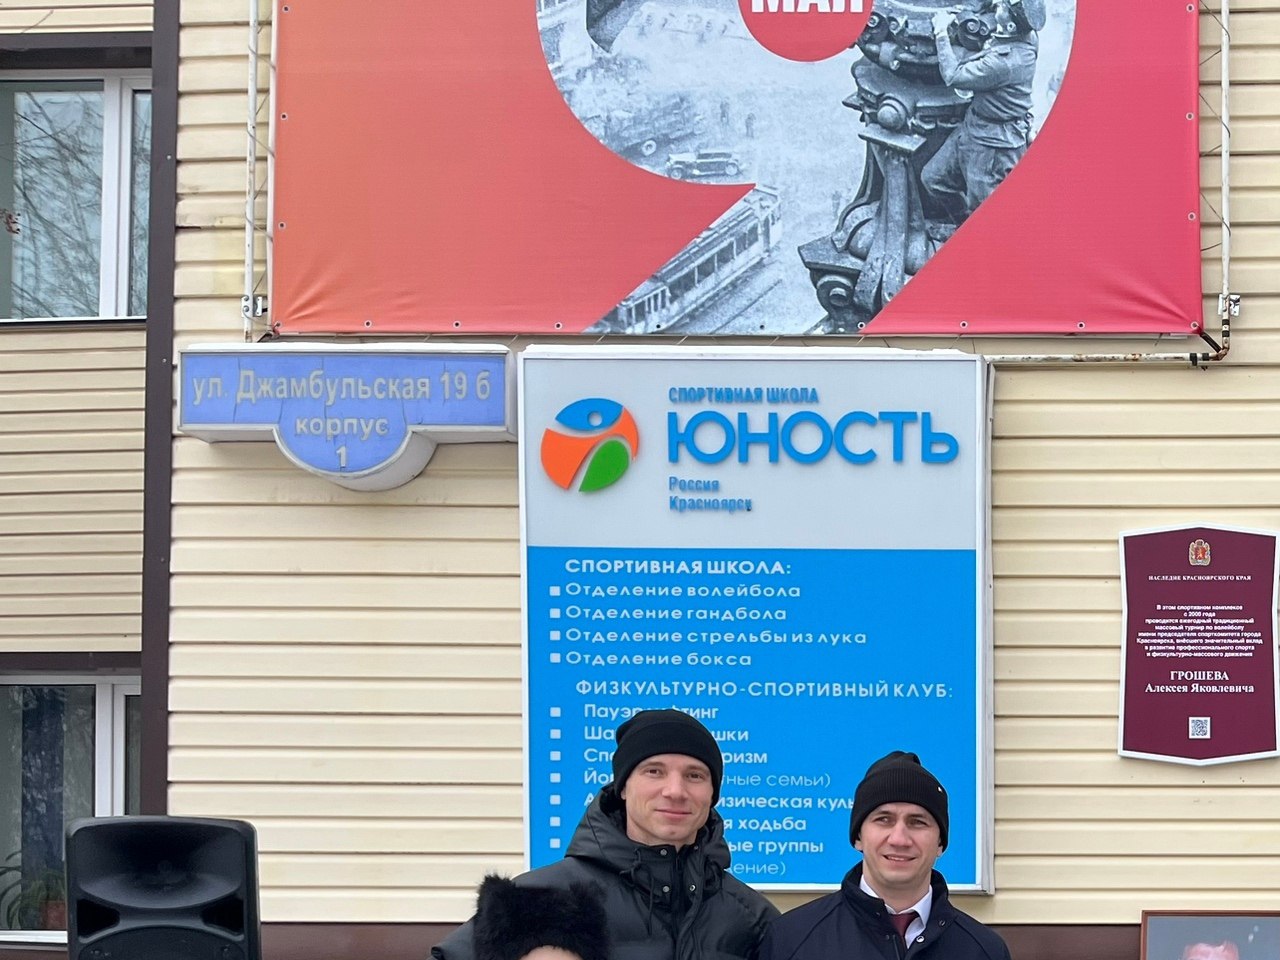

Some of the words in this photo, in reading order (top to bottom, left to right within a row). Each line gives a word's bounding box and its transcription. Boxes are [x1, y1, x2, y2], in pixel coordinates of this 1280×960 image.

[192, 376, 228, 405] ул.
[236, 369, 431, 405] Джамбульская
[440, 371, 468, 400] 19
[668, 387, 763, 404] СПОРТИВНАЯ
[766, 387, 820, 404] ШКОЛА
[295, 416, 389, 441] корпус
[667, 410, 959, 465] ЮНОСТЬ
[335, 446, 347, 468] 1
[669, 476, 720, 493] Россия
[669, 496, 752, 514] Красноярск
[565, 559, 703, 575] СПОРТИВНАЯ
[707, 560, 792, 575] ШКОЛА:
[565, 582, 683, 599] Отделение
[687, 583, 800, 598] волейбола
[565, 606, 683, 622] Отделение
[687, 606, 787, 622] гандбола
[565, 628, 683, 644] Отделение
[687, 629, 787, 645] стрельбы
[791, 631, 814, 644] из
[817, 631, 867, 646] лука
[565, 651, 683, 667] Отделение
[687, 651, 752, 666] бокса
[1170, 671, 1229, 681] ГРОШЕВА
[576, 679, 889, 698] ФИЗКУЛЬТУРНО-СПОРТИВНЫЙ
[894, 683, 953, 699] КЛУБ:
[1145, 683, 1188, 693] Алексея
[1190, 683, 1254, 693] Яковлевича
[766, 773, 831, 788] семьи)
[738, 816, 807, 832] ходьба
[758, 841, 824, 855] группы
